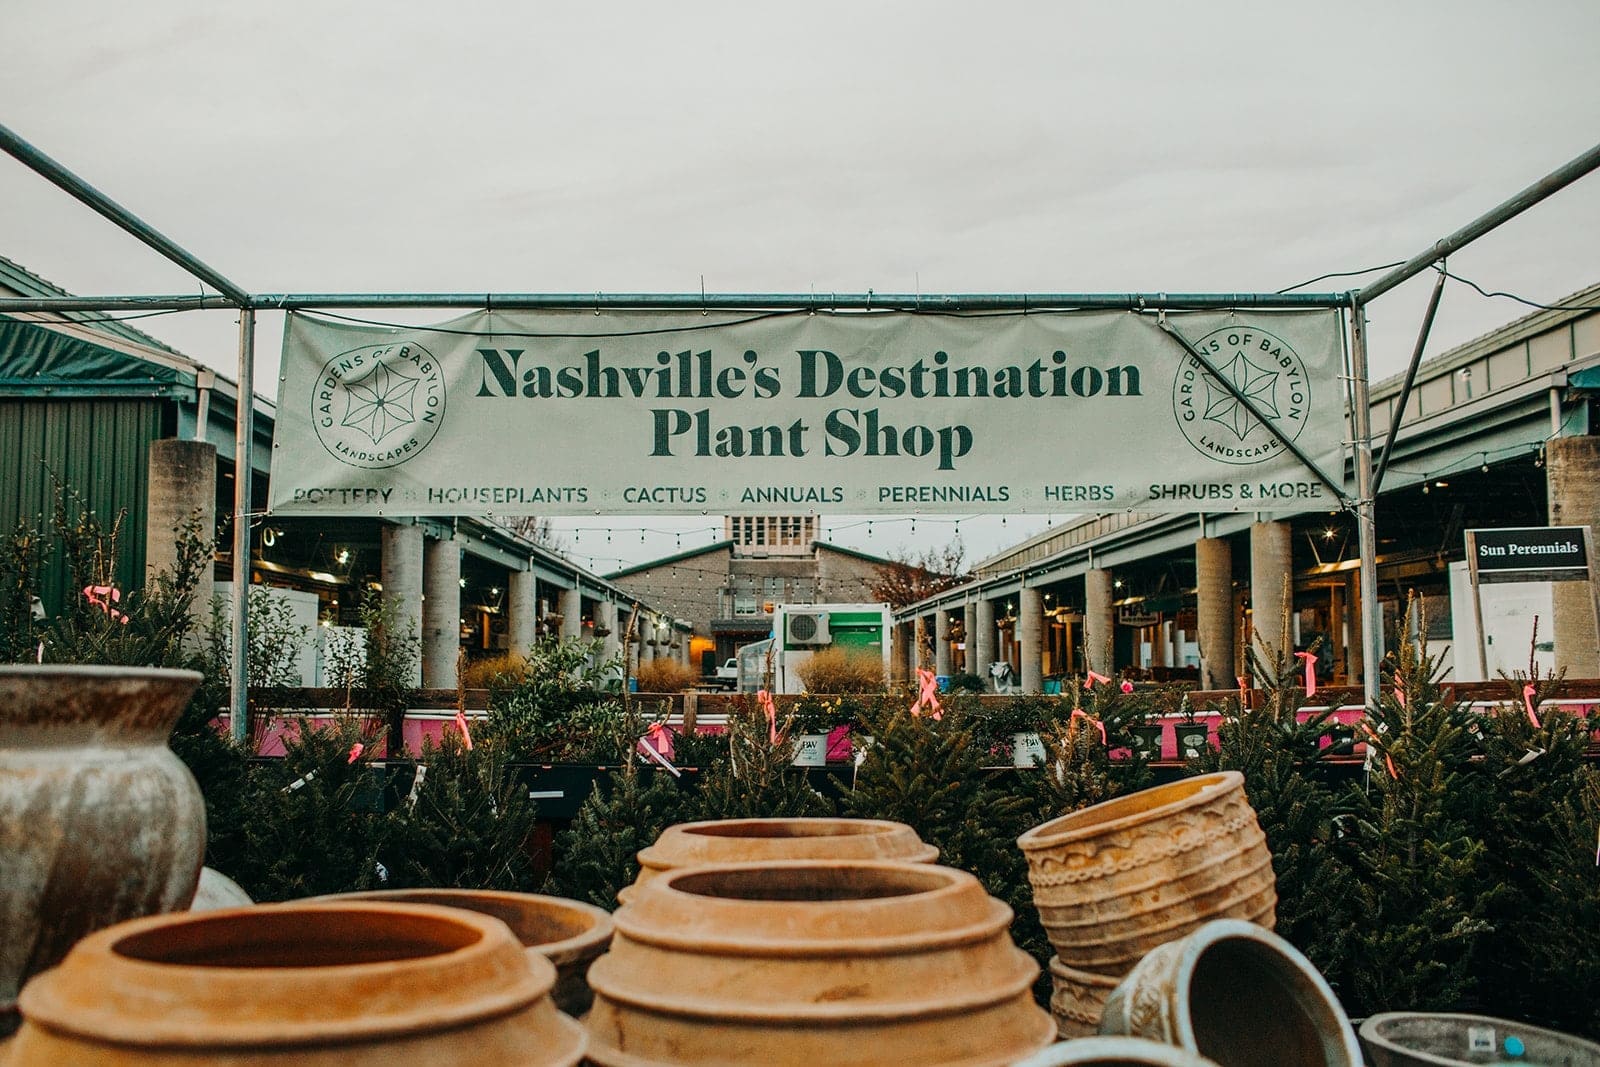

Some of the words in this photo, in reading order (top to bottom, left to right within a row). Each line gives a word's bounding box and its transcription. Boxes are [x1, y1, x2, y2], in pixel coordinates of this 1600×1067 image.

[320, 355, 364, 428] GARDENS
[372, 346, 395, 360] OF
[399, 346, 440, 424] BABYLON
[475, 349, 781, 399] Nashville's
[795, 350, 1143, 399] Destination
[1227, 334, 1253, 346] OF
[1259, 338, 1304, 420] BABYLON
[335, 438, 419, 461] LANDSCAPES
[649, 408, 810, 458] Plant
[825, 408, 974, 471] Shop
[1200, 435, 1284, 458] LANDSCAPE
[293, 487, 394, 505] POTTERY
[428, 487, 588, 504] HOUSEPLANTS
[623, 487, 707, 503] CACTUS
[740, 486, 844, 503] ANNUALS
[878, 486, 1010, 502] PERENNIALS
[1044, 485, 1114, 501] HERBS
[1149, 484, 1234, 500] SHRUBS
[1239, 483, 1253, 499] &
[1259, 482, 1322, 499] MORE
[1480, 544, 1506, 556] Sun
[1508, 541, 1579, 555] Perennials
